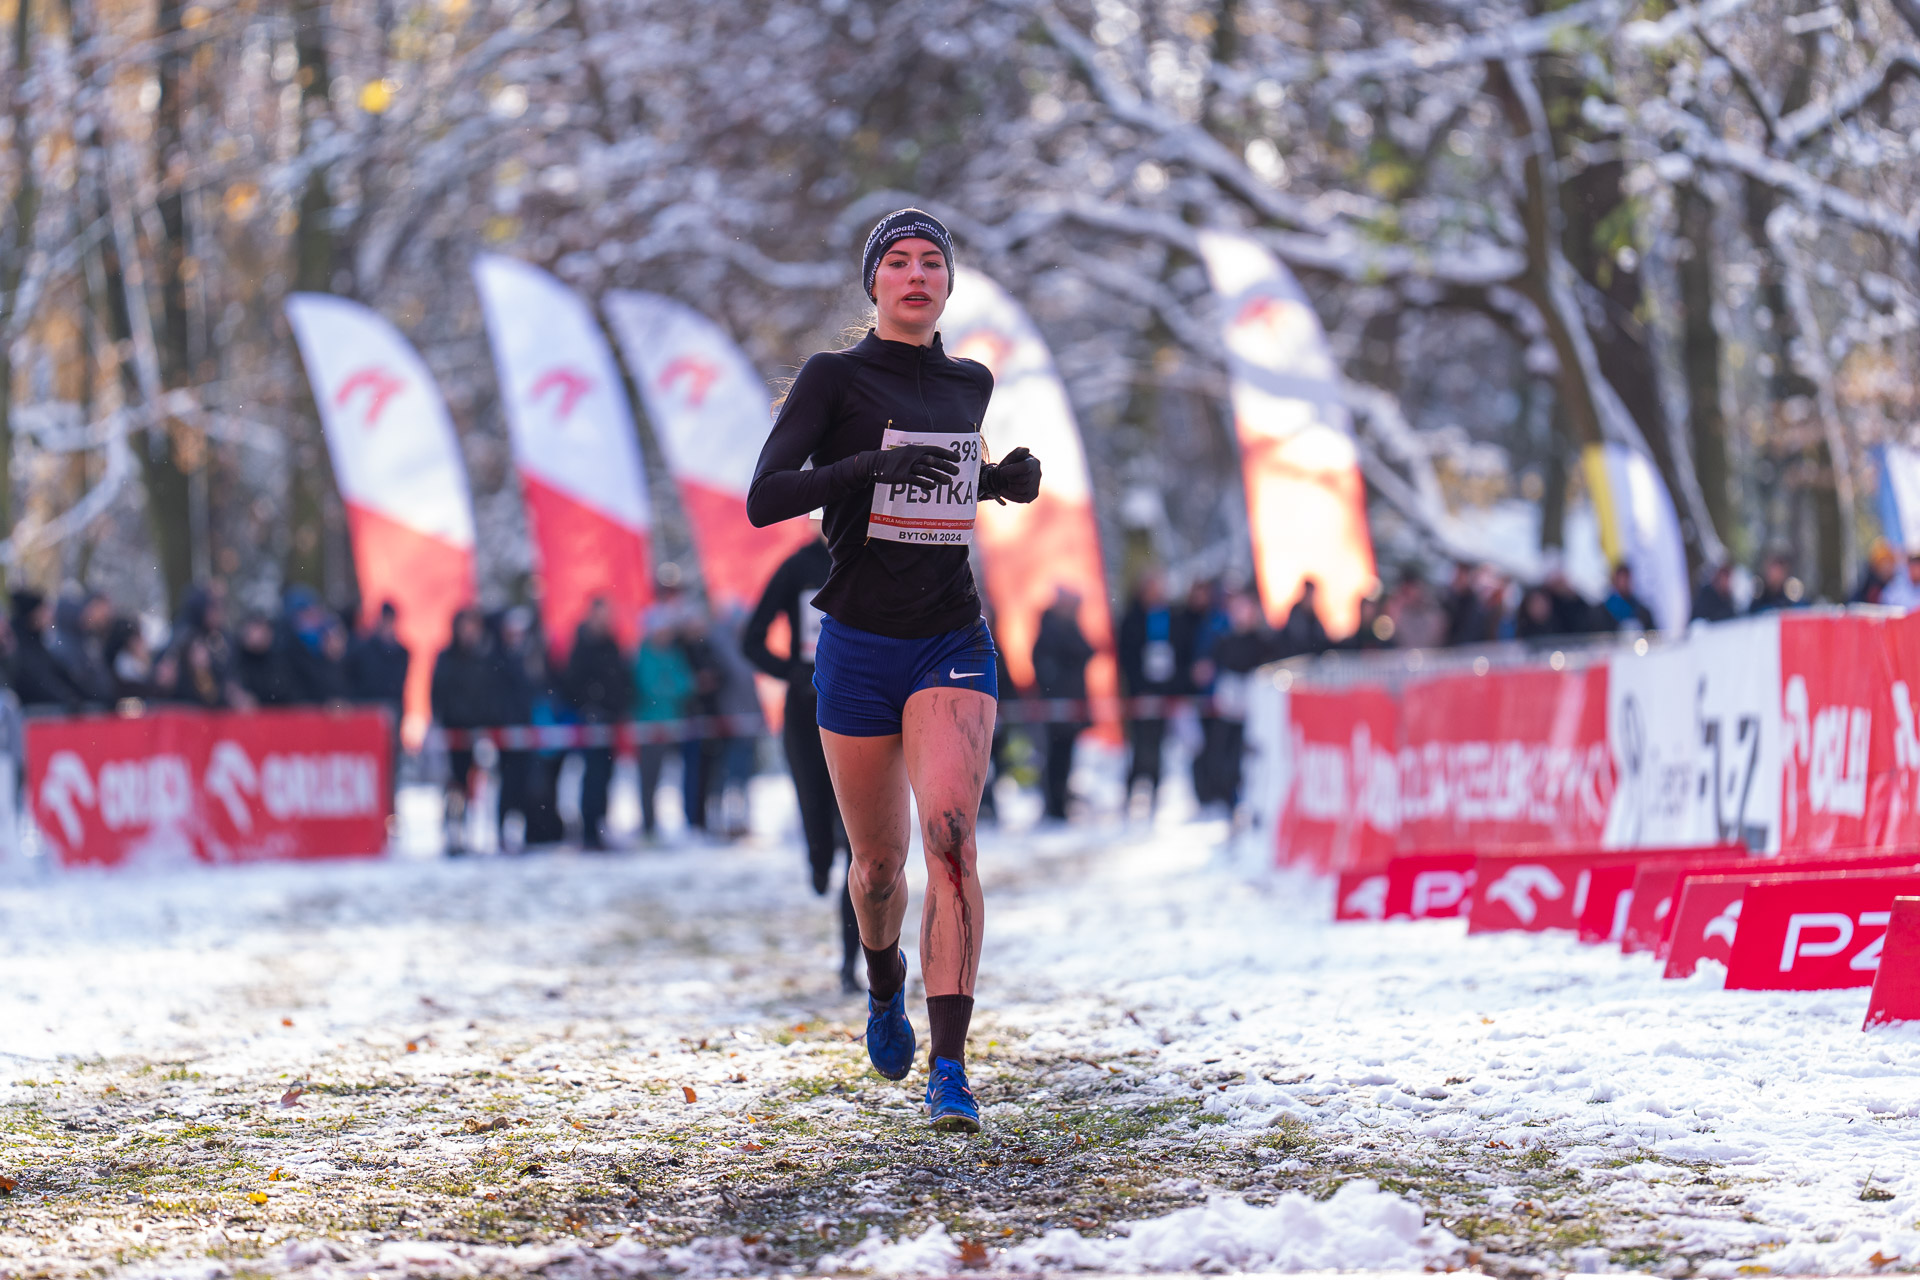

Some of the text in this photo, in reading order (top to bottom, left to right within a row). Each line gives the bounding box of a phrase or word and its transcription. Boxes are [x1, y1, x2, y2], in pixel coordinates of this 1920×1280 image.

[950, 440, 978, 462] 393
[889, 481, 974, 505] PESTKA
[898, 531, 962, 542] BYTOM 2024
[1778, 911, 1891, 973] PZ
